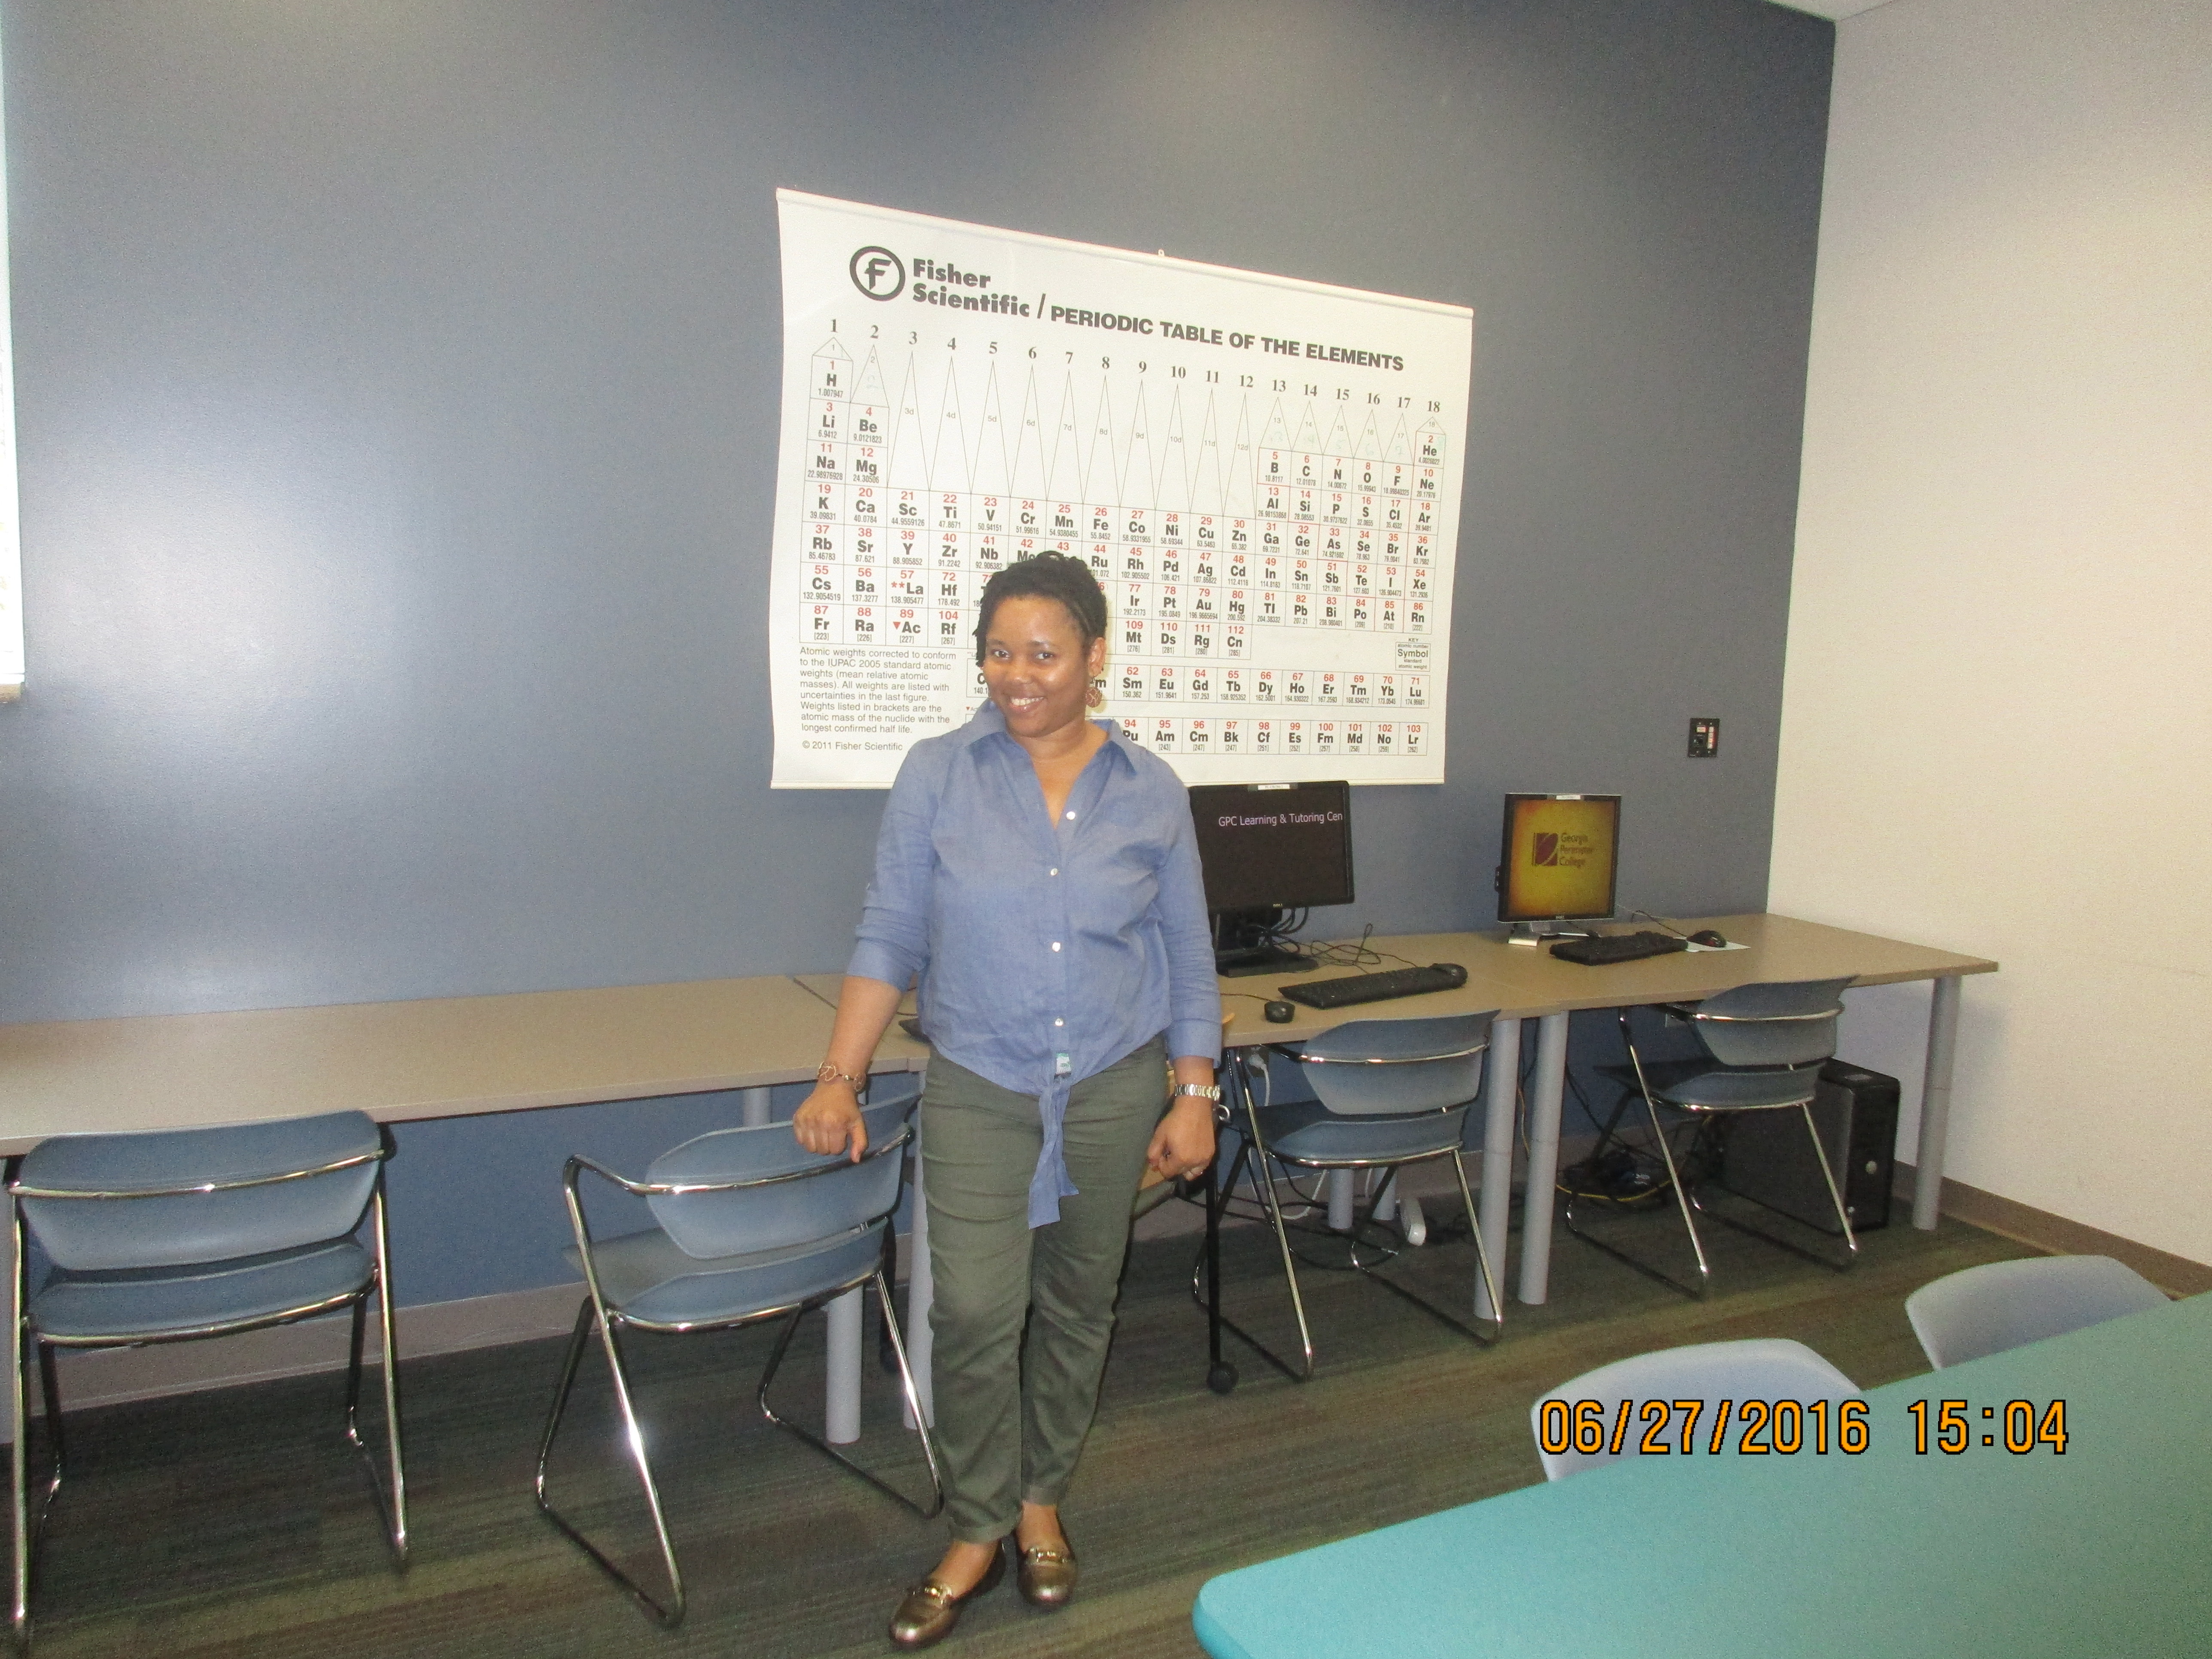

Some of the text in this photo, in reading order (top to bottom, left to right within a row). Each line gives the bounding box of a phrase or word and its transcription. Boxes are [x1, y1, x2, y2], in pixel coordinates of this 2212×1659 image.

[913, 258, 991, 289] Fisher
[912, 283, 1030, 317] Scientific
[1051, 305, 1153, 335] PERIODIC
[1159, 321, 1223, 346] TABLE
[1229, 332, 1255, 349] OF
[1261, 337, 1300, 357] THE
[1306, 343, 1404, 371] ELEMENTS
[830, 360, 835, 370] 1
[830, 318, 1441, 413] 1 2 3 4 5 6 7 8 9 10 11 12 13 14 15 16 17 18
[826, 373, 837, 387] H
[823, 414, 835, 428] Li
[859, 419, 877, 433] Be
[1423, 444, 1437, 456] He
[816, 455, 835, 469] Na
[1270, 462, 1279, 473] B
[818, 484, 831, 494] 19
[1420, 478, 1434, 490] Ne
[859, 487, 873, 497] 20
[901, 491, 913, 500] 21
[818, 496, 829, 510] K
[943, 494, 957, 504] 22
[1267, 498, 1279, 509] Al
[856, 499, 875, 513] Ca
[899, 503, 917, 516] Sc
[1095, 507, 1107, 517] 26
[1300, 500, 1310, 512] Si
[943, 506, 957, 519] Ti
[986, 509, 995, 521] V
[1021, 512, 1036, 525] Cr
[1418, 512, 1431, 523] Ar
[1055, 515, 1073, 528] Mn
[1094, 518, 1109, 531] Fe
[1129, 521, 1146, 534] Co
[815, 524, 830, 534] 37
[1166, 524, 1179, 536] Ni
[1198, 527, 1214, 539] Cu
[1232, 530, 1246, 542] Zn
[813, 537, 832, 550] Rb
[857, 540, 874, 553] Sr
[902, 543, 913, 555] Y
[1387, 543, 1399, 554] Br
[942, 545, 958, 557] Zr
[981, 547, 998, 560] Nb
[814, 565, 829, 574] 55
[1127, 558, 1144, 570] Rh
[1294, 570, 1308, 581] Sn
[812, 577, 831, 590] Cs
[855, 580, 875, 592] Ba
[941, 583, 957, 596] Hf
[1413, 578, 1426, 590] Xe
[1196, 599, 1212, 611] Au
[1294, 605, 1308, 616] Pb
[939, 611, 958, 620] 104
[814, 617, 830, 630] Fr
[855, 619, 874, 632] Ra
[941, 623, 956, 635] Rf
[1126, 620, 1143, 629] 109
[1126, 631, 1142, 643] Mt
[1227, 636, 1243, 647] Cn
[800, 646, 830, 656] Atomic
[833, 648, 866, 659] weights
[869, 650, 909, 658] corrected
[922, 651, 956, 659] conform
[1398, 648, 1428, 659] Symbol
[811, 658, 825, 666] the
[828, 658, 856, 667] IUPAC
[859, 659, 881, 668] 2005
[884, 661, 921, 669] standard
[924, 662, 951, 670] atomic
[800, 669, 928, 680] weights (mean relative atomic
[800, 681, 839, 690] masses).
[842, 681, 853, 689] All
[855, 682, 889, 692] weights
[908, 682, 930, 691] listed
[1123, 677, 1142, 689] Sm
[800, 691, 929, 702] uncertainties in the last figure.
[800, 701, 835, 712] Weights
[838, 702, 860, 711] listed
[863, 702, 871, 711] in
[874, 703, 910, 712] brackets
[929, 705, 942, 713] the
[801, 713, 829, 721] atomic
[857, 714, 866, 722] of
[868, 714, 882, 722] the
[885, 714, 915, 723] nuclide
[937, 715, 950, 723] the
[801, 723, 832, 734] longest
[834, 724, 877, 733] confirmed
[880, 725, 895, 733] half
[1155, 730, 1175, 741] Am
[1257, 732, 1270, 743] Cf
[1317, 732, 1334, 743] Fm
[1408, 734, 1419, 744] Lr
[812, 741, 831, 749] 2011
[835, 741, 862, 750] Fisher
[864, 741, 902, 751] Scientific
[1218, 811, 1343, 826] GPC Learning & Tutoring Cen
